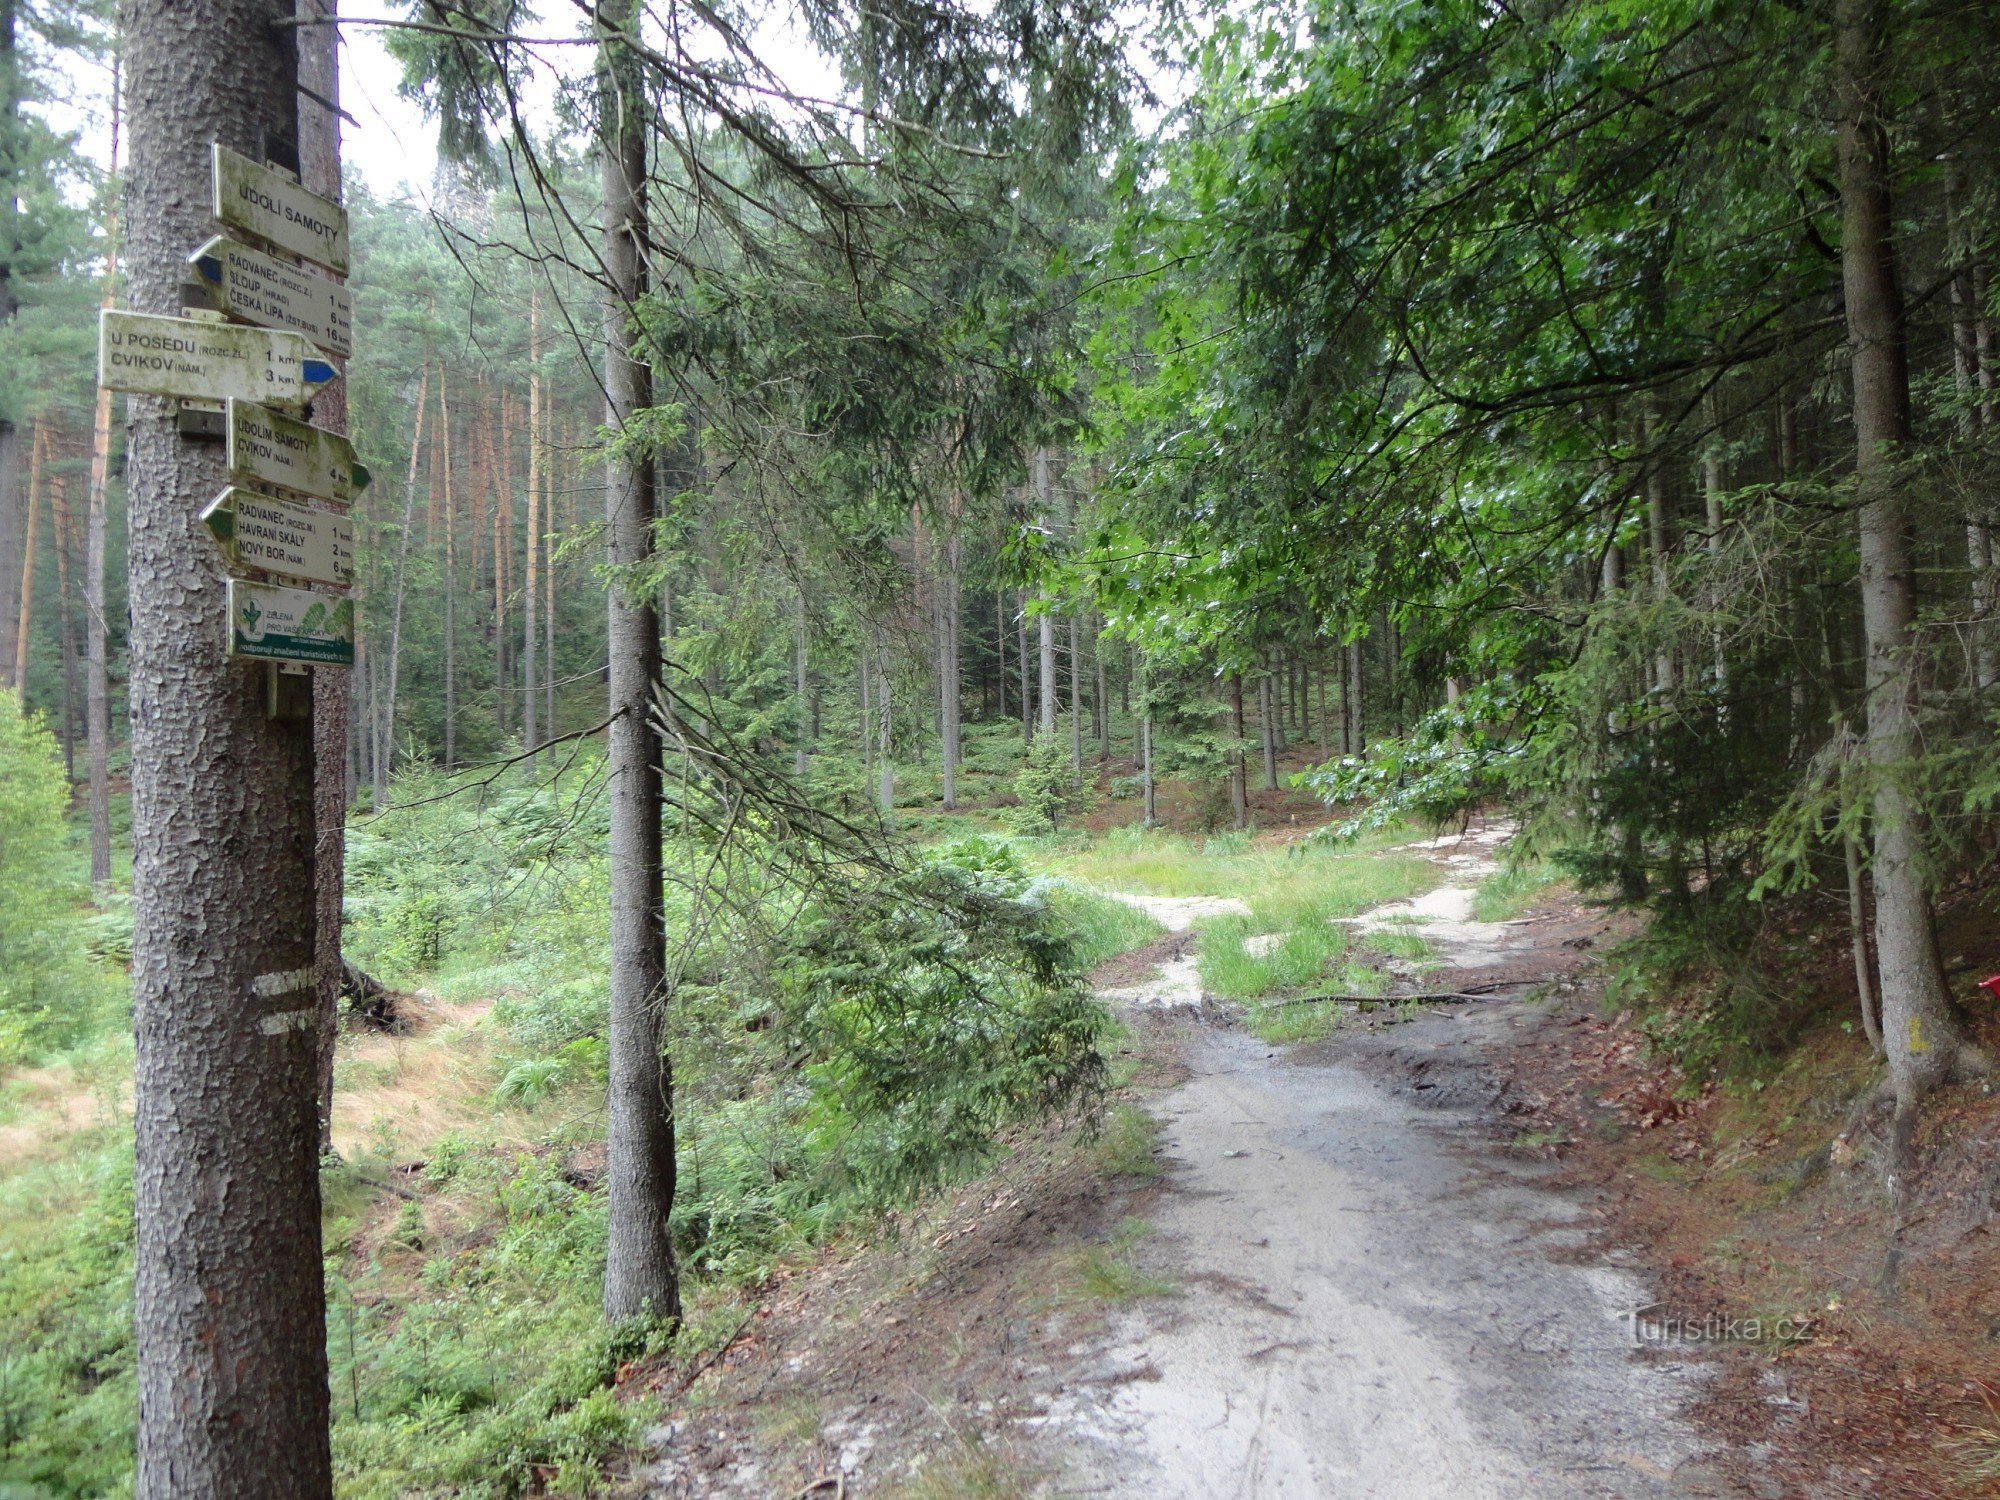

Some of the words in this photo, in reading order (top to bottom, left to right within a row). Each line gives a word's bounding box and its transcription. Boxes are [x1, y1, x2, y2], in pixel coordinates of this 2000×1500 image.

[285, 206, 338, 241] SAMOTY
[229, 253, 278, 283] RADVANEC
[330, 295, 335, 306] 1
[338, 301, 349, 312] km
[229, 271, 260, 292] SLOUP
[263, 288, 290, 306] (HRAD)
[331, 312, 336, 323] 6
[338, 319, 349, 329] km
[229, 287, 262, 312] ČESKÁ
[264, 303, 284, 320] LÍPA
[326, 327, 338, 341] 16
[338, 335, 350, 345] km
[111, 332, 122, 346] U
[128, 333, 196, 353] POSEDU
[265, 350, 272, 361] 1
[278, 355, 295, 366] km
[111, 352, 174, 370] CVIKOV
[174, 364, 206, 377] (NÁM.)
[265, 369, 274, 382] 3
[278, 375, 295, 384] km
[238, 438, 272, 458] CVIKOV
[330, 468, 336, 479] 4
[274, 432, 310, 453] SAMOTY
[239, 502, 284, 524] RADVANEC
[332, 527, 337, 538] 1
[340, 533, 351, 541] km
[239, 521, 277, 541] HAVRANÍ
[278, 531, 305, 547] SKÁLY
[333, 544, 339, 556] 2
[340, 549, 351, 558] km
[239, 540, 264, 556] NOVÝ
[266, 546, 285, 560] BOR
[333, 561, 339, 572] 6
[266, 623, 281, 632] PRO
[283, 625, 302, 636] VAŠE
[300, 649, 338, 661] turistických
